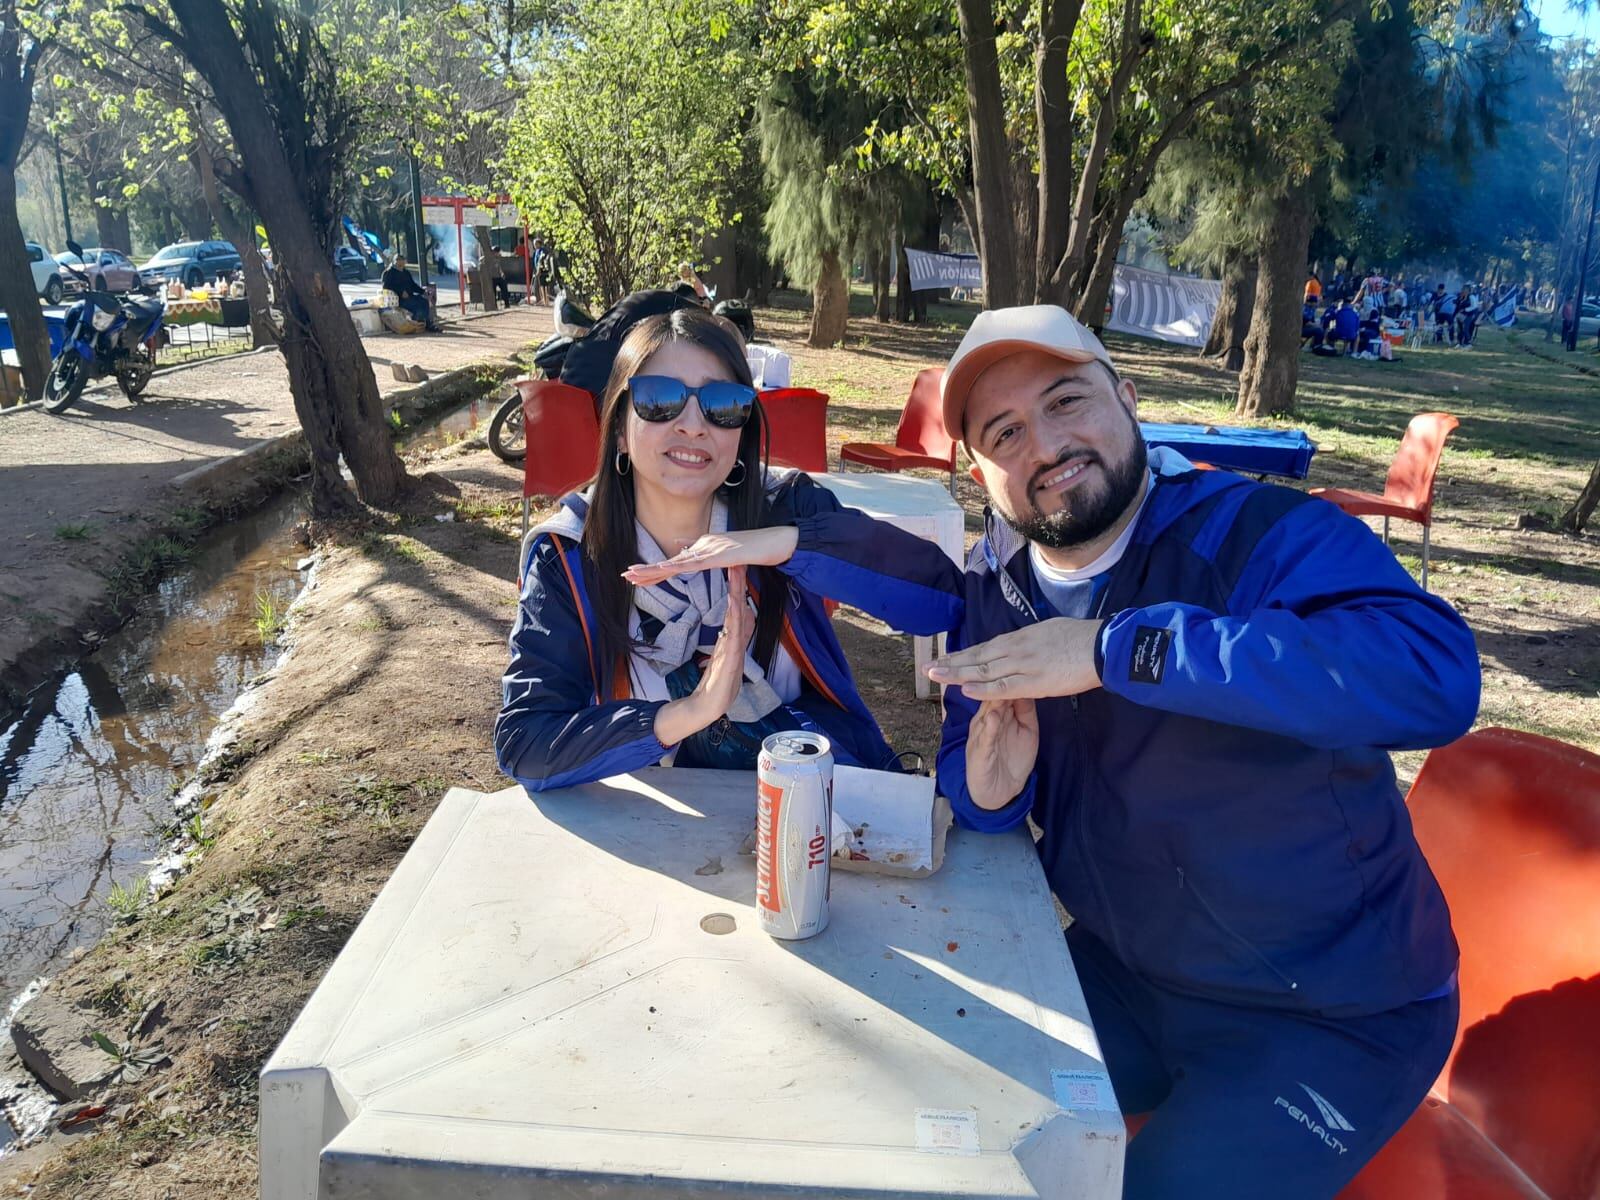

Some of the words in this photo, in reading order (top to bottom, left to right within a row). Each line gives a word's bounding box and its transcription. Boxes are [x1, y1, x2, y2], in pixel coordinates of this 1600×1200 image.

[1149, 631, 1162, 668] PENALTY
[808, 835, 825, 870] 710
[1273, 1095, 1348, 1155] PENALTY
